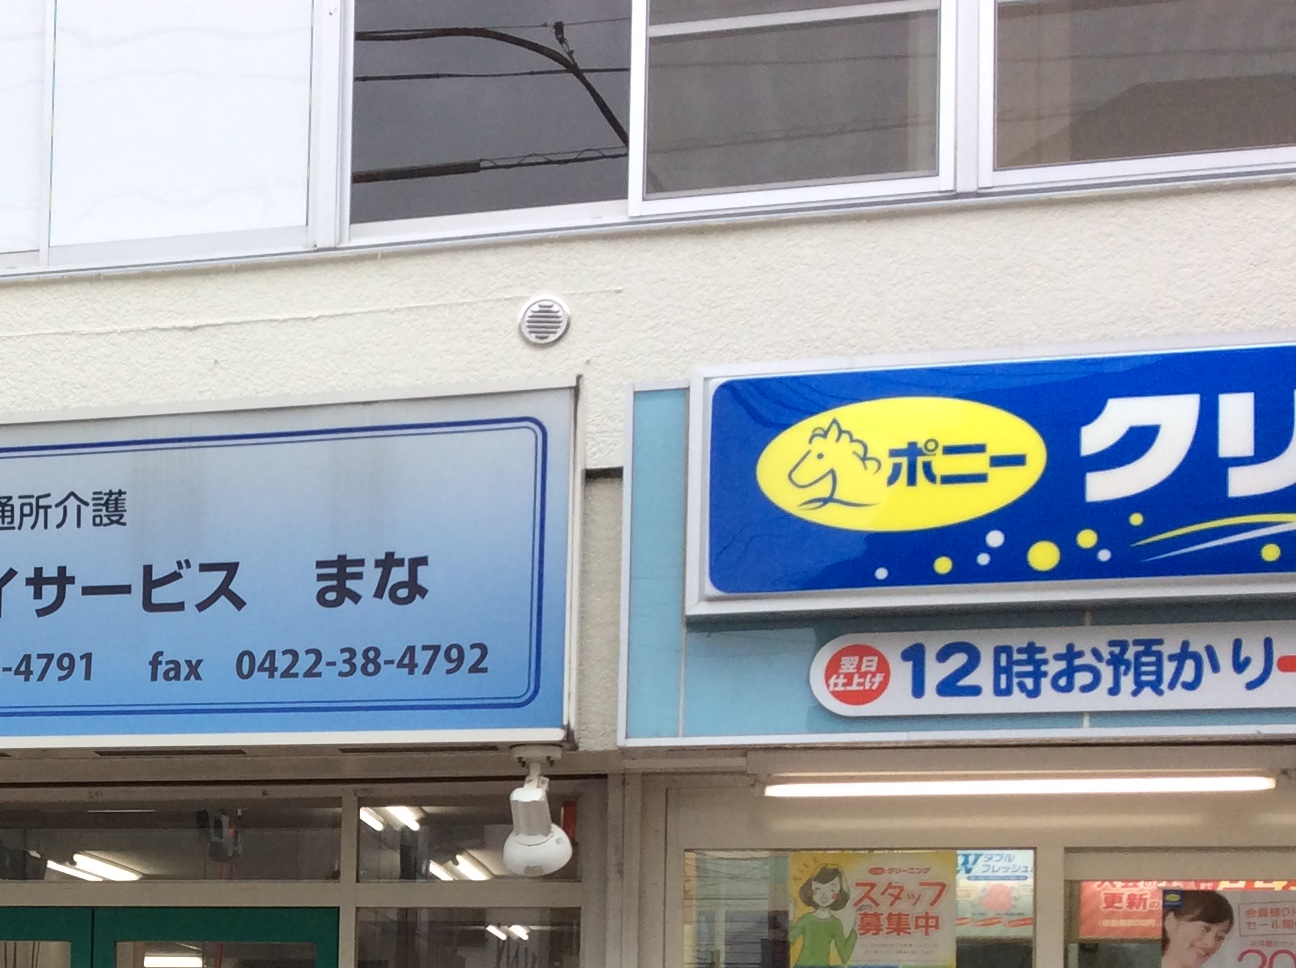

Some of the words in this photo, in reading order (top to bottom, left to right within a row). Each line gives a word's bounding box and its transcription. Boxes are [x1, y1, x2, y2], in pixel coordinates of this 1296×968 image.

[887, 438, 1027, 488] ポニー
[313, 550, 429, 608] まな
[149, 650, 203, 684] fax
[235, 641, 490, 681] 0422-38-4792
[839, 655, 878, 674] 翌日
[900, 636, 1275, 700] 12時お預かり
[828, 672, 885, 692] 仕上げ
[853, 880, 947, 908] スタッフ
[858, 913, 941, 938] 募集中
